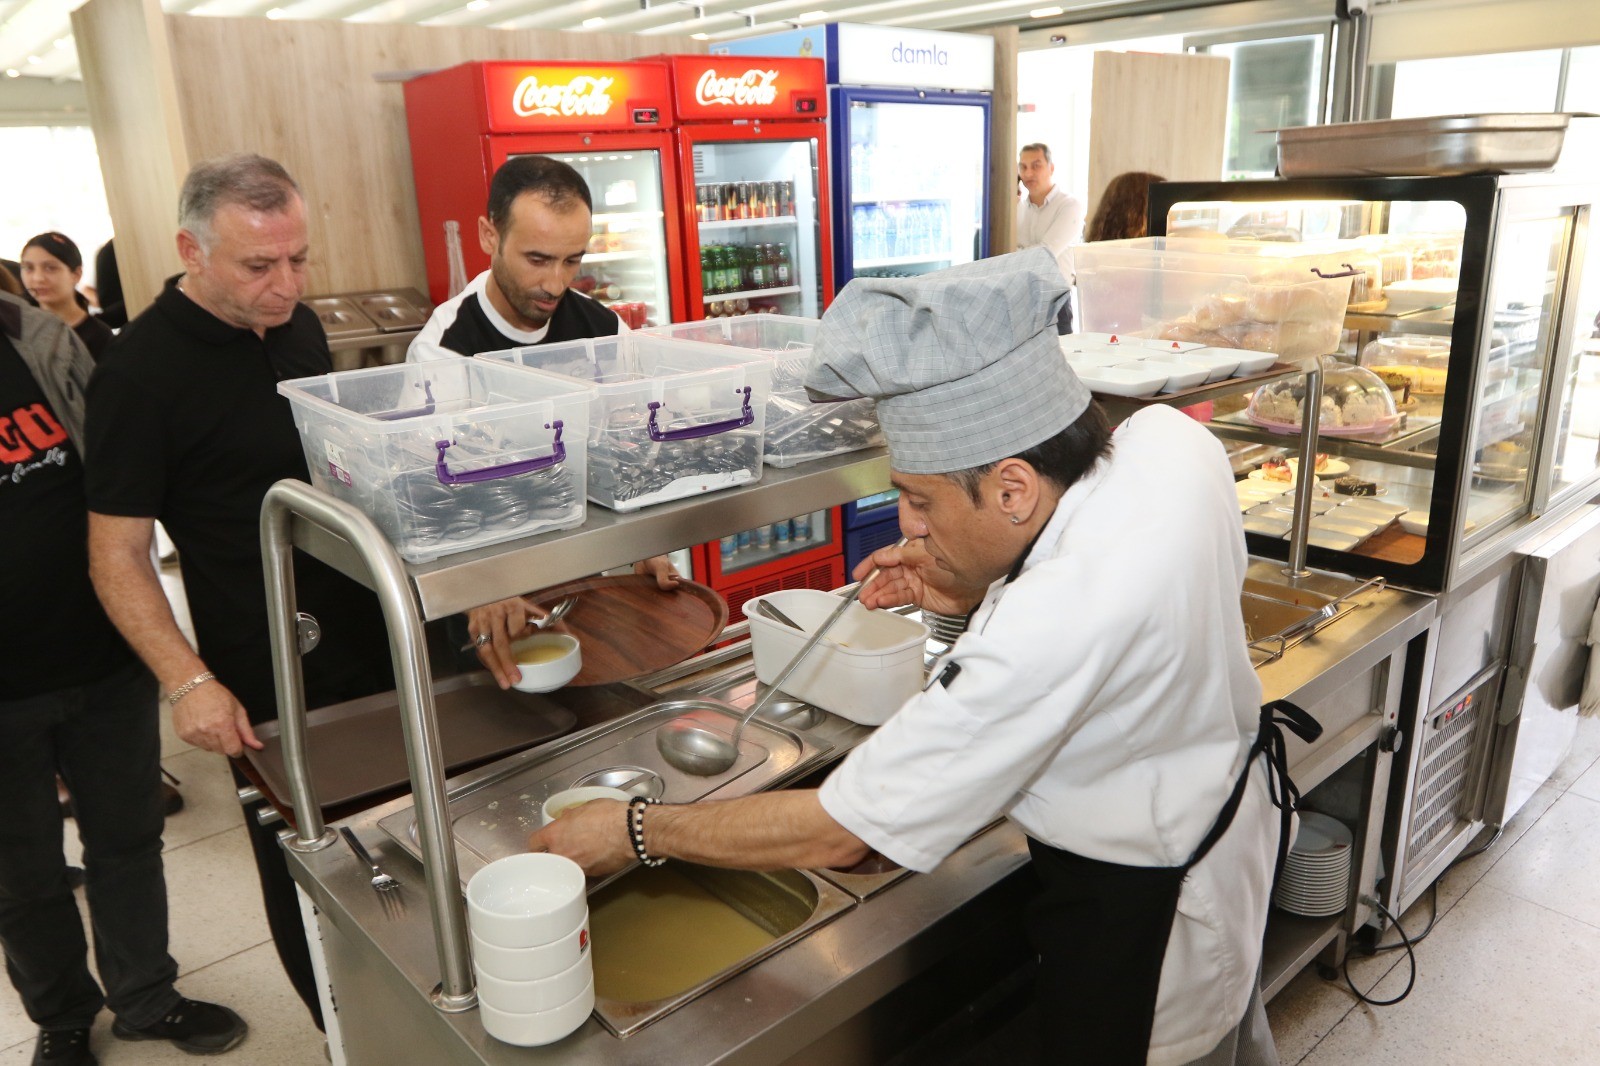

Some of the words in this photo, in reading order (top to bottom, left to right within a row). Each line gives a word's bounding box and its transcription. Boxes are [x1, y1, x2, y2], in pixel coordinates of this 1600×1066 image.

[891, 40, 948, 66] damla
[512, 75, 614, 117] Coca-Cola
[695, 68, 780, 106] Coca-Cola
